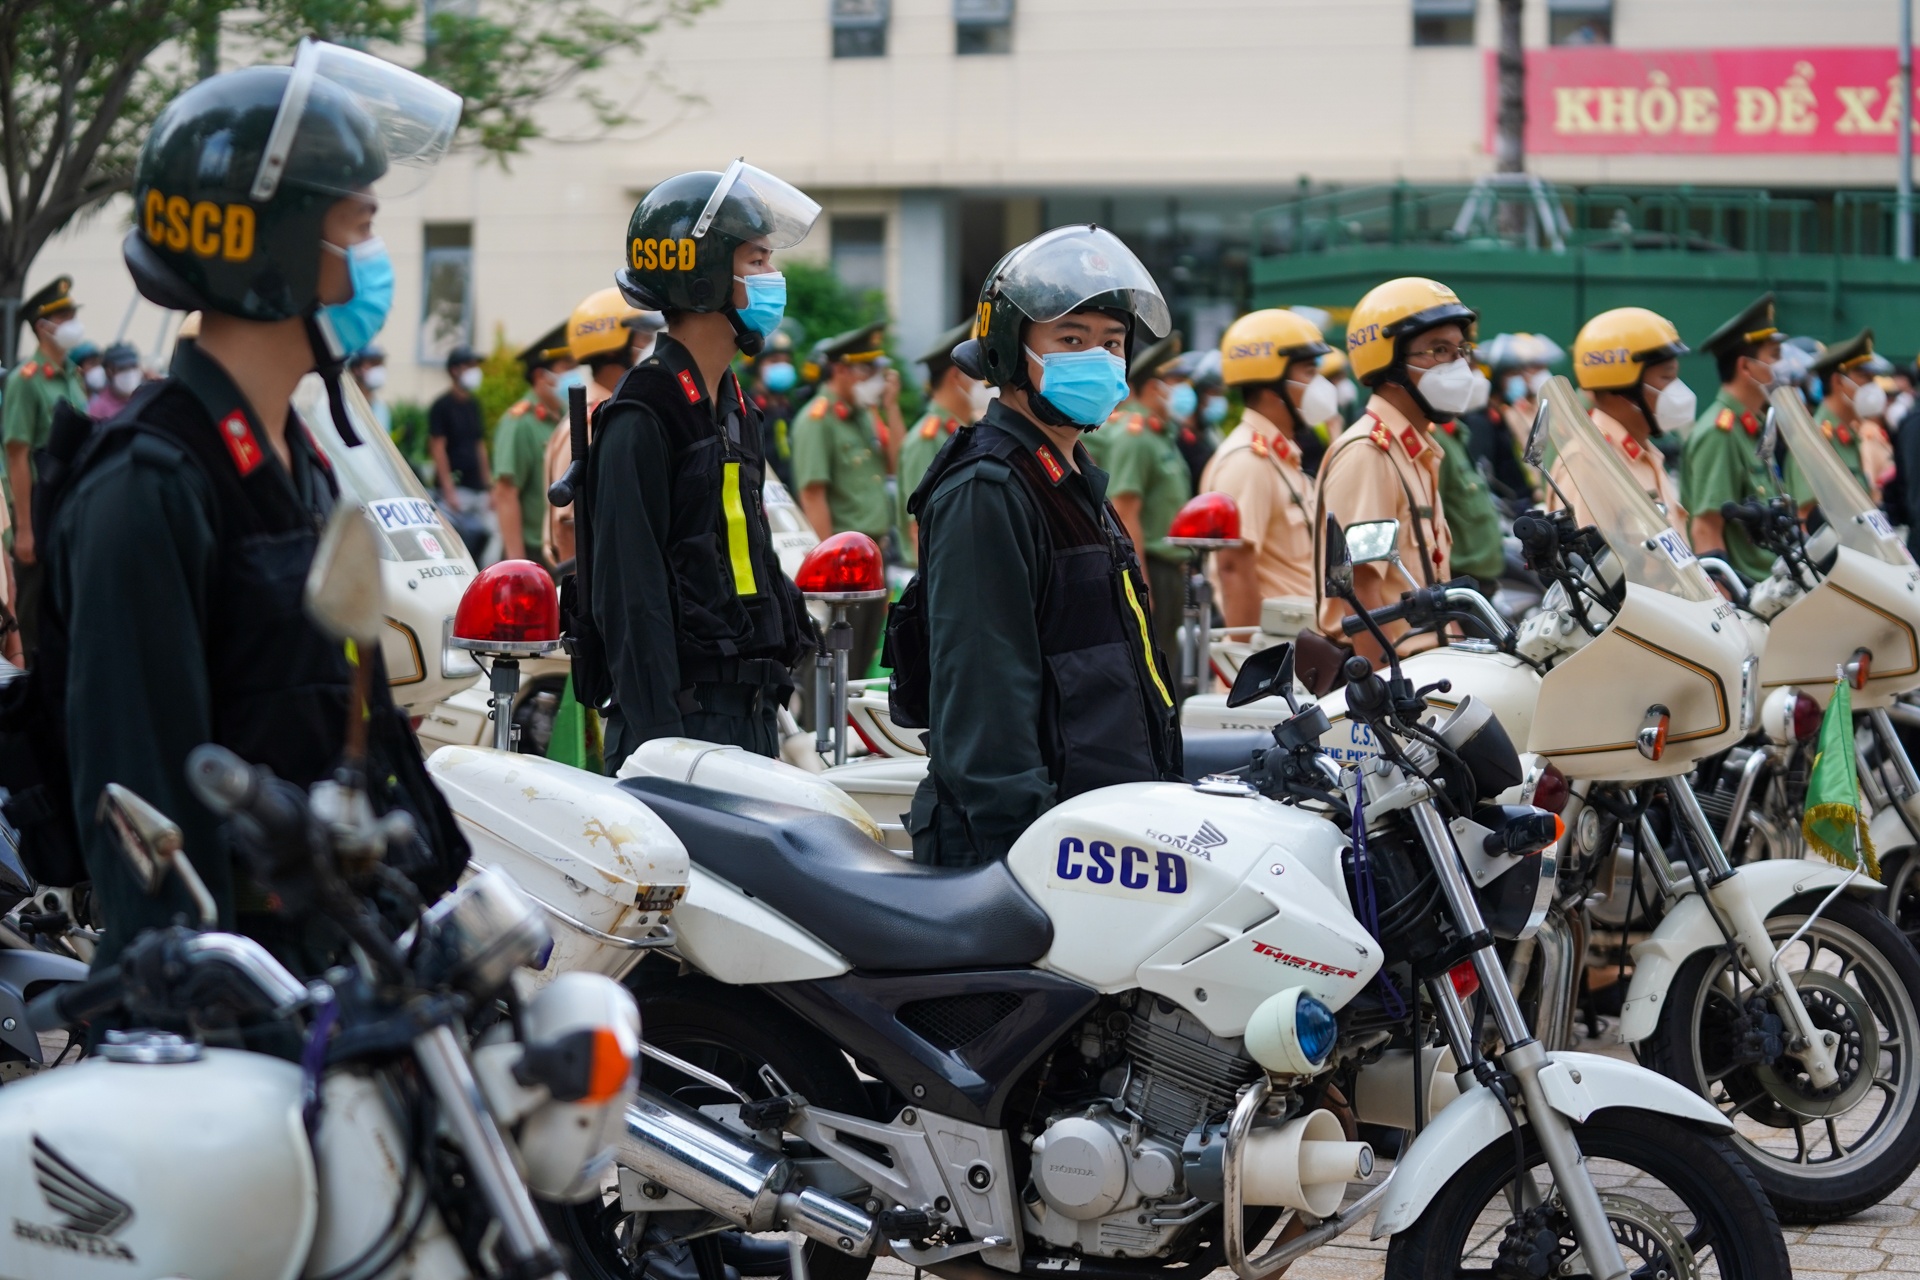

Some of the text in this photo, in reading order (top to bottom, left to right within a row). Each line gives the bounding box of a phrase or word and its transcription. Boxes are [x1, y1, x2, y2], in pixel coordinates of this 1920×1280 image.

[1553, 69, 1720, 135] KHỎE
[144, 187, 256, 262] CSCĐ
[632, 237, 696, 271] CSCĐ
[1348, 323, 1379, 350] SGT
[1583, 347, 1630, 367] CSGT
[375, 501, 440, 528] POLICE
[1660, 531, 1692, 563] POL
[418, 565, 470, 579] HONDA
[1146, 828, 1212, 862] HONDA
[1056, 836, 1188, 894] CSCĐ
[1049, 1164, 1097, 1177] HONDA
[11, 1217, 137, 1262] HONDA
